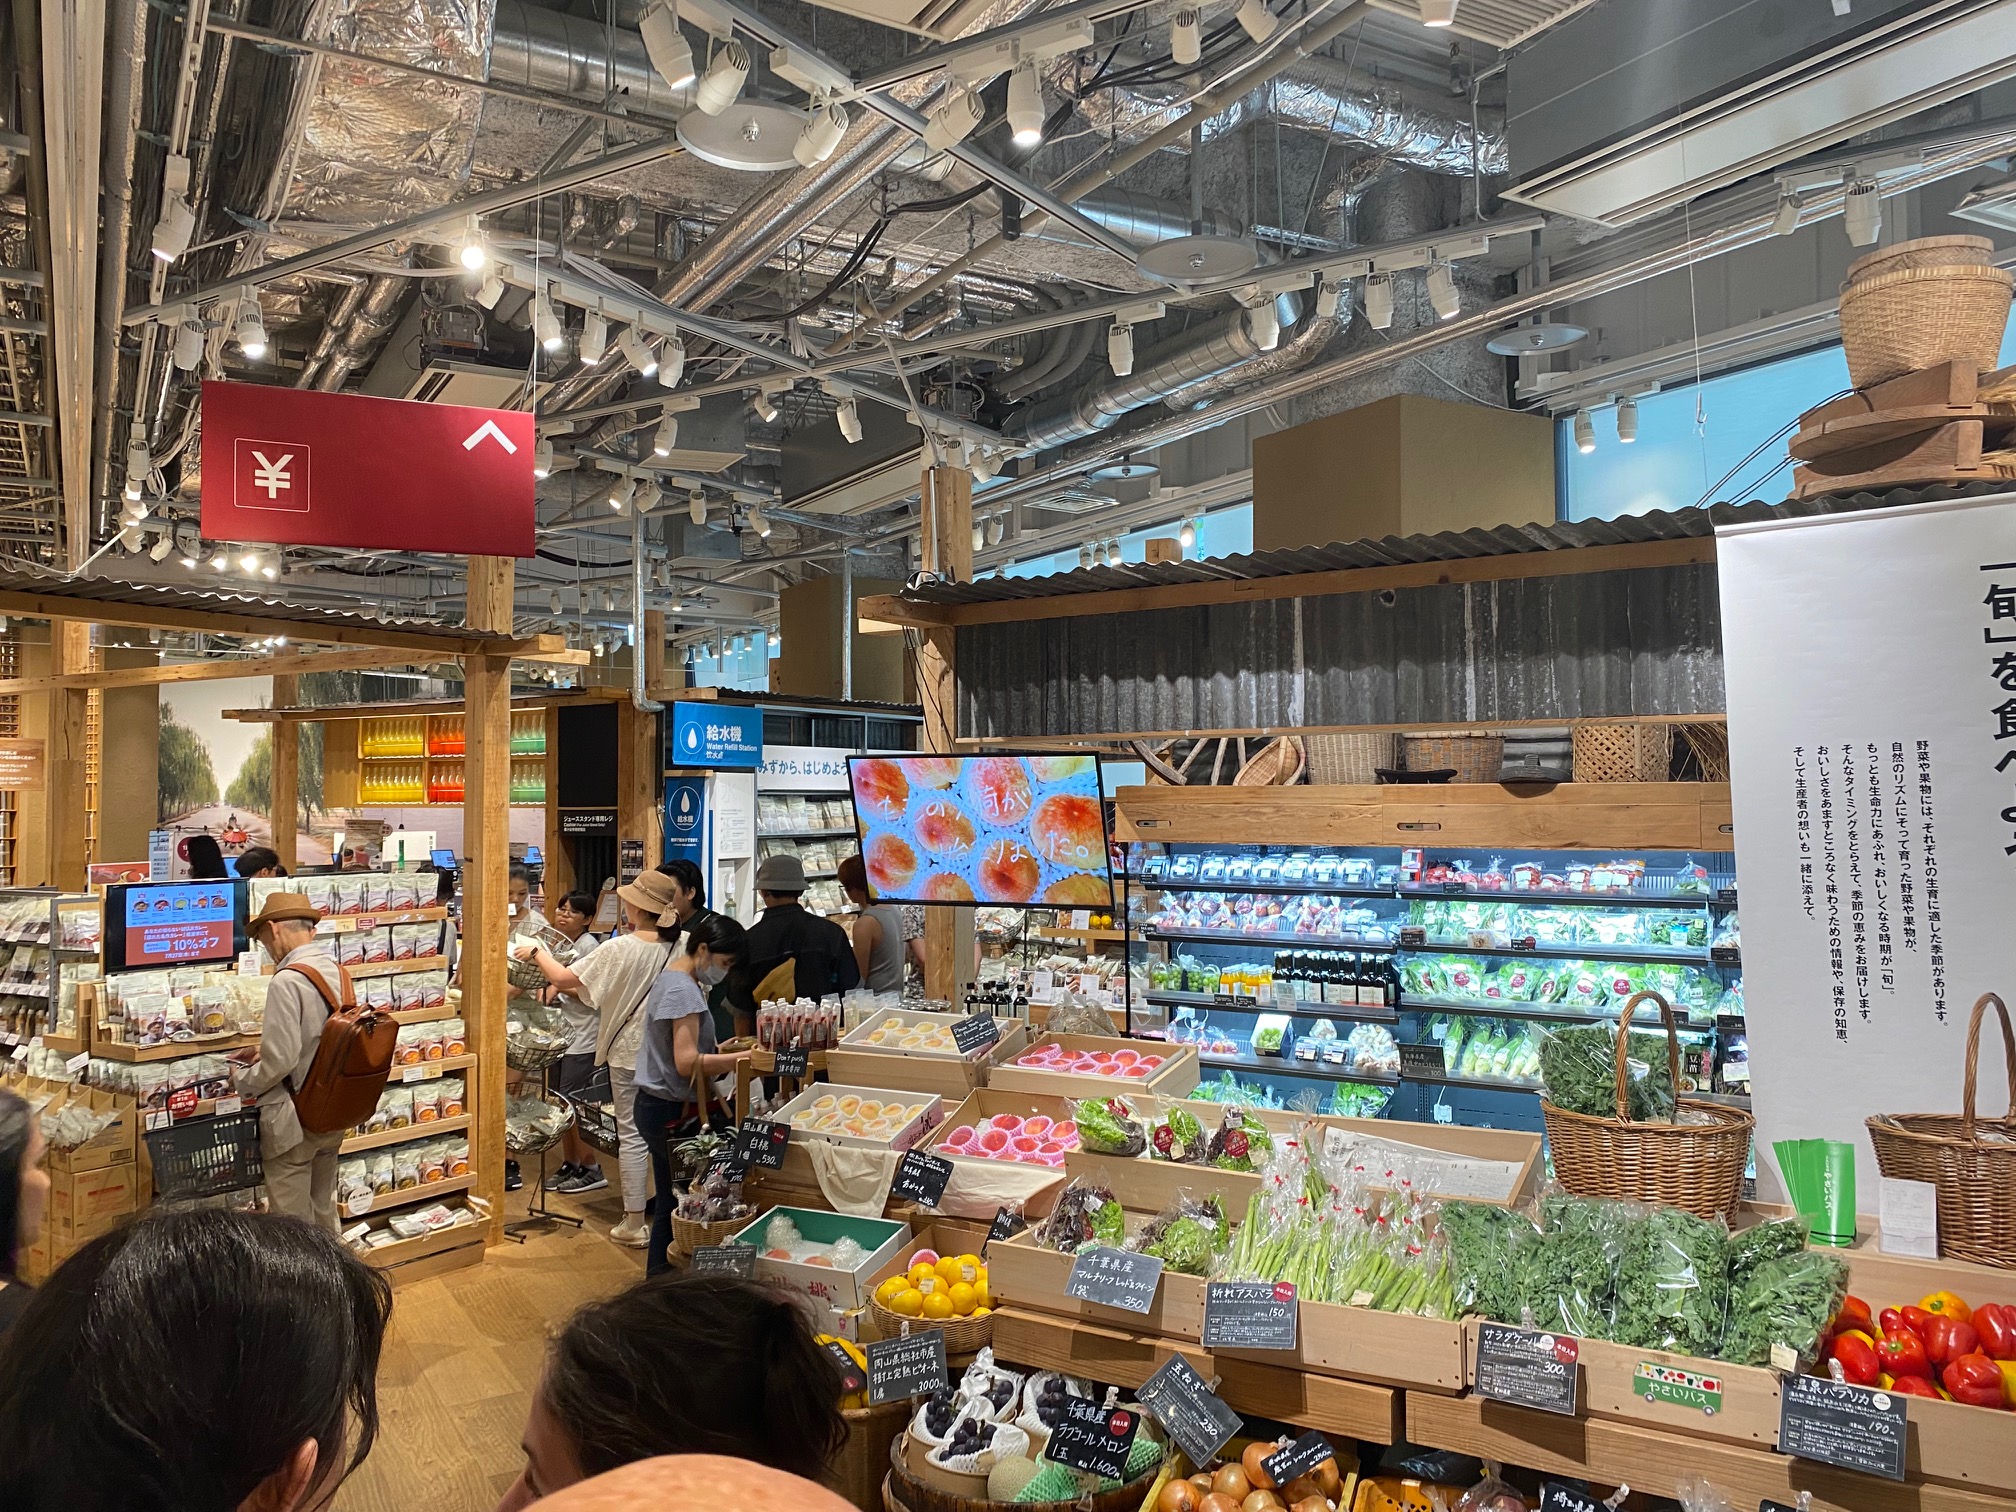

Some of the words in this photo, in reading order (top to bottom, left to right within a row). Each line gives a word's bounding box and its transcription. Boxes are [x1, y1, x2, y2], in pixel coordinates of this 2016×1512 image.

[706, 724, 742, 743] 給水機
[706, 742, 724, 751] Water
[724, 743, 738, 752] Refill
[738, 744, 758, 752] Station
[757, 760, 848, 776] みずから、はじめよう
[1793, 746, 1816, 921] そして生産者の想いも一緒に添えて。
[1891, 741, 1917, 953] 自然のリズムにそって育った野菜や果物が、
[1866, 742, 1895, 996] もっとも生命力にあふれ、おいしくなる時期が「旬」。
[1817, 745, 1848, 1044] おいしさをあますところなく味わうための情報や、保存の知恵、
[1841, 743, 1872, 1025] そんなタイミングをとらえて、季節の恵みをお届けします。
[1916, 740, 1949, 1027] 野菜や果物には、それぞれの生育に適した季節があります。
[173, 937, 219, 951] 10%オフ
[777, 1052, 790, 1060] Don't
[791, 1055, 804, 1063] push
[750, 1136, 769, 1150] 白桃
[1088, 1254, 1134, 1273] 千葉県産
[1212, 1287, 1274, 1299] 折れアスパラ
[1485, 1328, 1540, 1348] サラダケール
[873, 1345, 937, 1370] 岡山県総社市産
[872, 1360, 940, 1384] 樹上完熟ピオーネ
[1170, 1361, 1206, 1392] 玉ねぎ
[1648, 1381, 1707, 1404] やさいバス
[1792, 1378, 1870, 1406] 温泉パプリカ
[1067, 1400, 1107, 1425] 千葉県産
[1057, 1423, 1097, 1446] ラブコール
[1096, 1435, 1130, 1454] メロン
